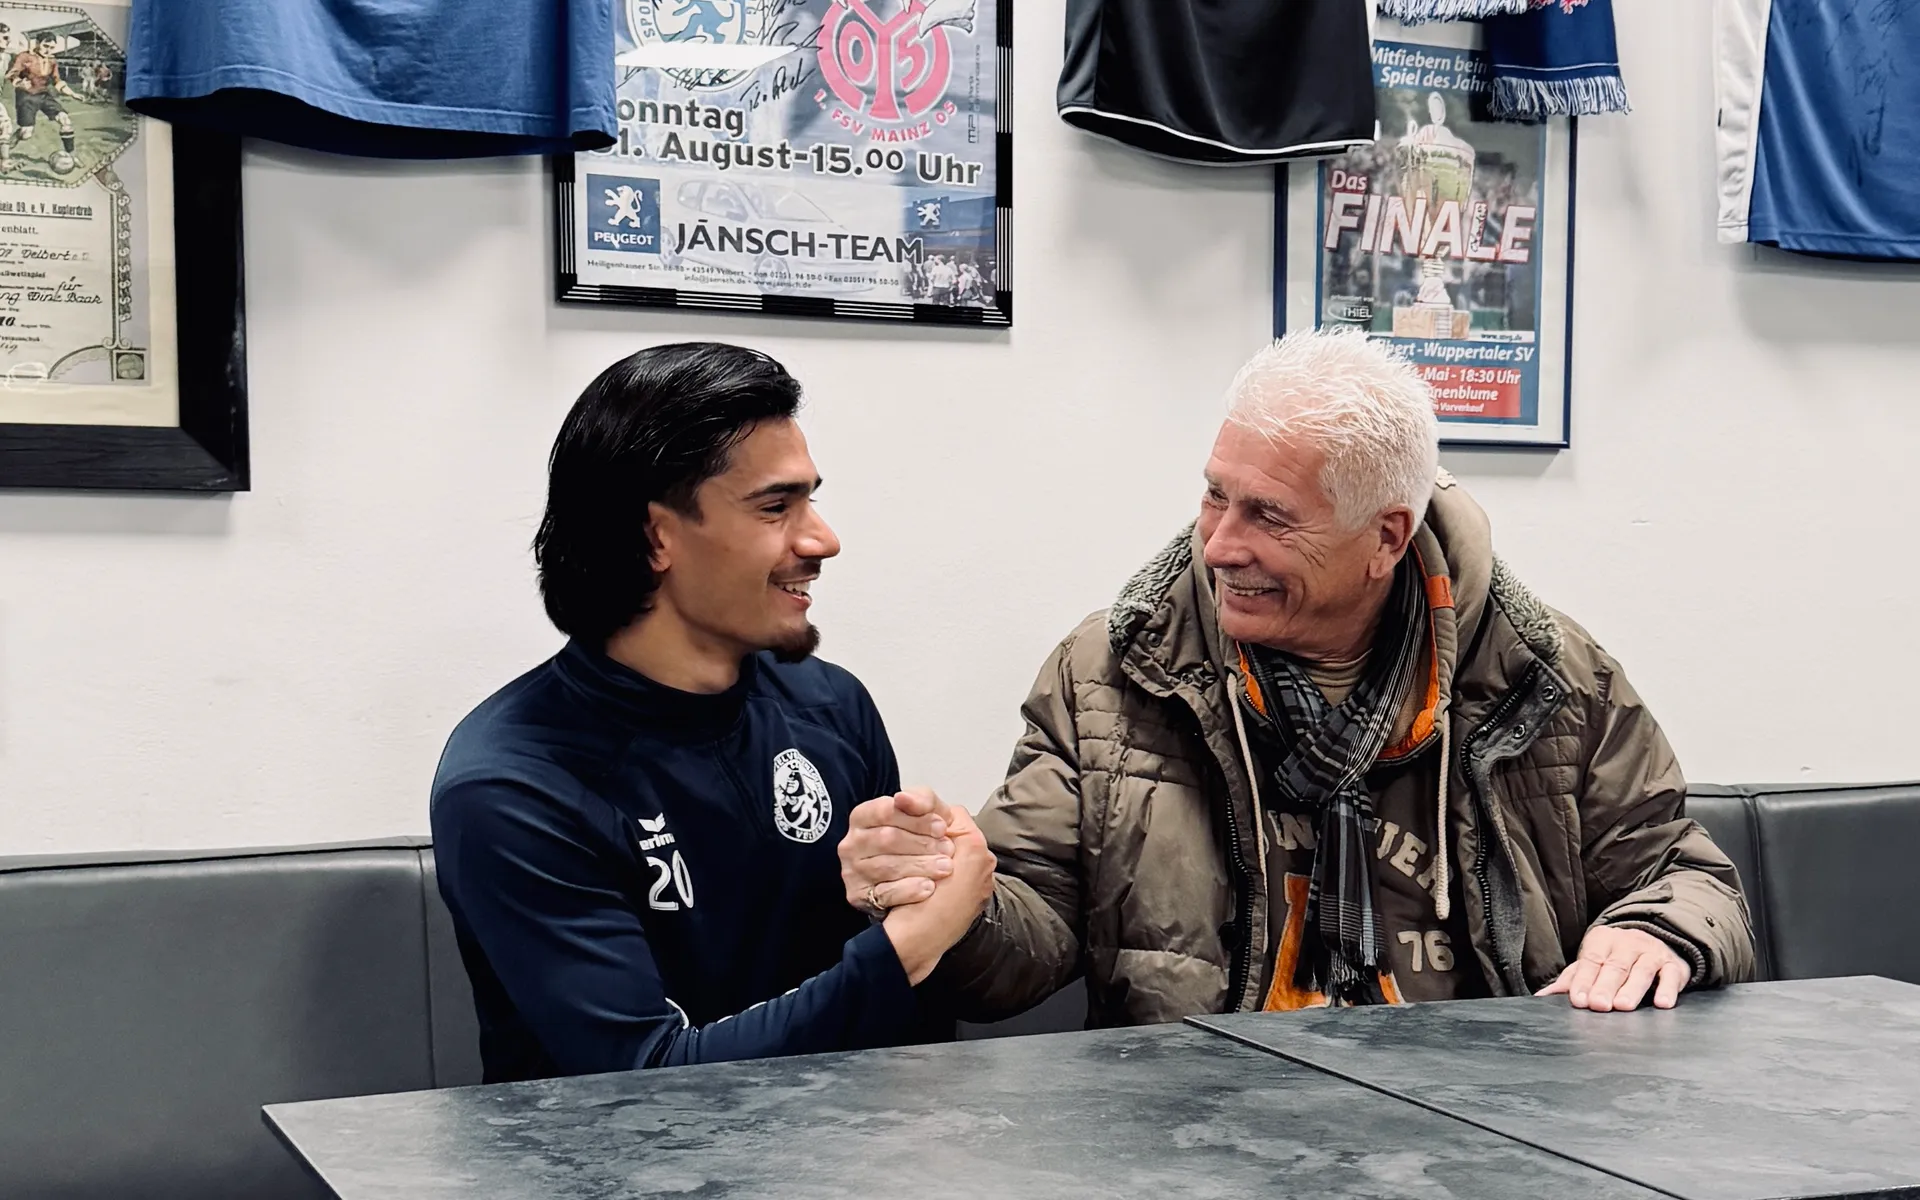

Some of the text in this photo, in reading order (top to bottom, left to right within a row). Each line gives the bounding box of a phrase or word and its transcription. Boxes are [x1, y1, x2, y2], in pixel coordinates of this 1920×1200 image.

[1371, 46, 1450, 71] Mitfiebern
[1380, 66, 1421, 88] Spiel
[1423, 71, 1450, 89] des
[617, 98, 744, 137] onntag
[831, 107, 865, 136] FSV
[870, 121, 933, 143] MAINZ
[590, 127, 644, 157] 1.
[918, 152, 982, 185] Uhr
[1331, 170, 1368, 191] Das
[0, 226, 39, 235] enblatt.
[1324, 191, 1537, 263] FINALE
[594, 231, 654, 249] PEUGEOT
[1343, 306, 1373, 318] THIEL
[1423, 342, 1513, 362] Wuppertaler
[1514, 347, 1534, 362] SV
[1424, 367, 1450, 381] Mai
[1460, 369, 1494, 384] 18:30
[1496, 373, 1521, 385] Uhr
[639, 833, 676, 850] erim
[645, 849, 694, 911] 20
[1397, 930, 1454, 972] 76
